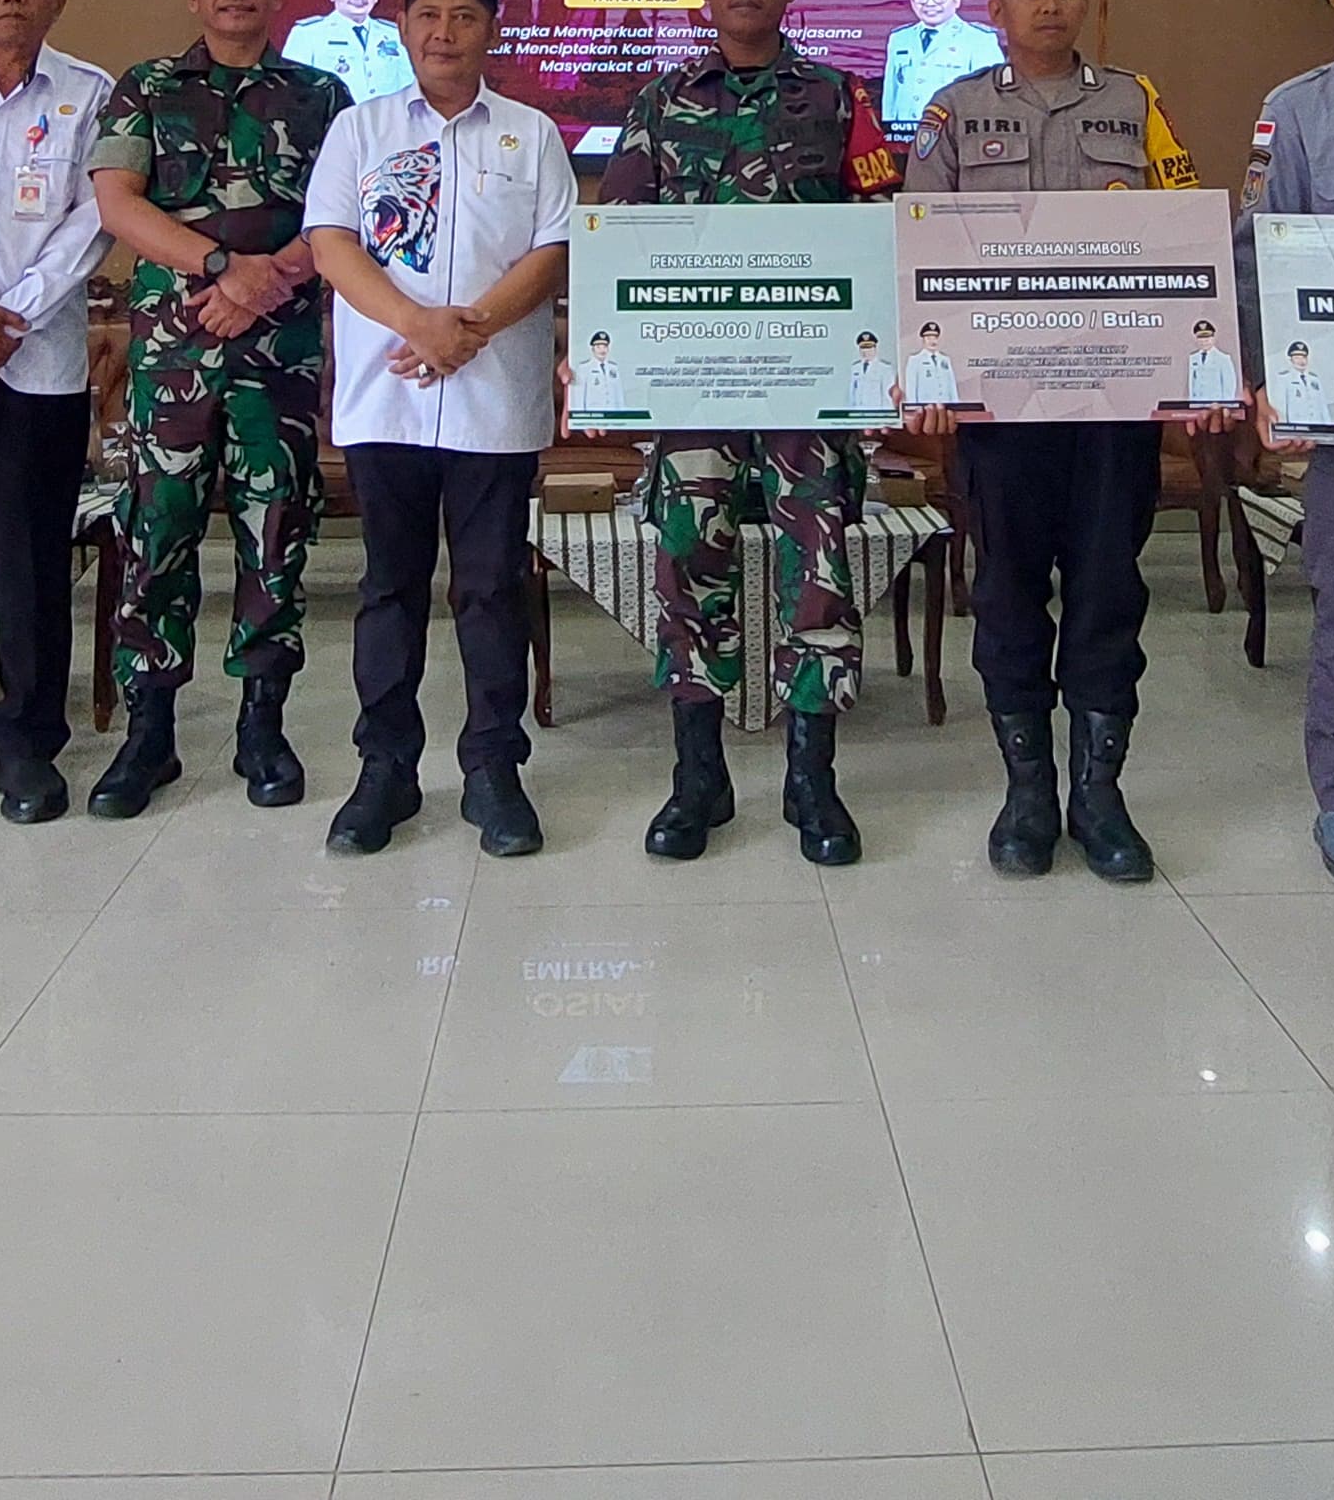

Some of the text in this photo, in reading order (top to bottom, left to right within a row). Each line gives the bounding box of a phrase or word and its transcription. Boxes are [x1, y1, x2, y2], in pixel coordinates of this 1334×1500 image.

[500, 25, 550, 40] angka
[554, 25, 654, 41] Memperkuat
[657, 26, 718, 38] Kemitra
[516, 42, 618, 58] Menciptakan
[622, 43, 709, 56] Keamanan
[539, 60, 632, 75] Masyarakat
[636, 60, 652, 72] di
[964, 119, 1139, 137] RIRI POLRI
[981, 241, 1141, 257] PENYERAHAN SIMBOLIS
[650, 253, 812, 269] PENYERAHAN SIMBOLIS
[923, 274, 1210, 293] INSENTIF BHABINKAMTIBMAS
[629, 286, 841, 304] INSENTIF BABINSA
[971, 310, 1164, 332] Rp500.000 / Bulan
[641, 321, 828, 343] Rp500.000 / Bulan
